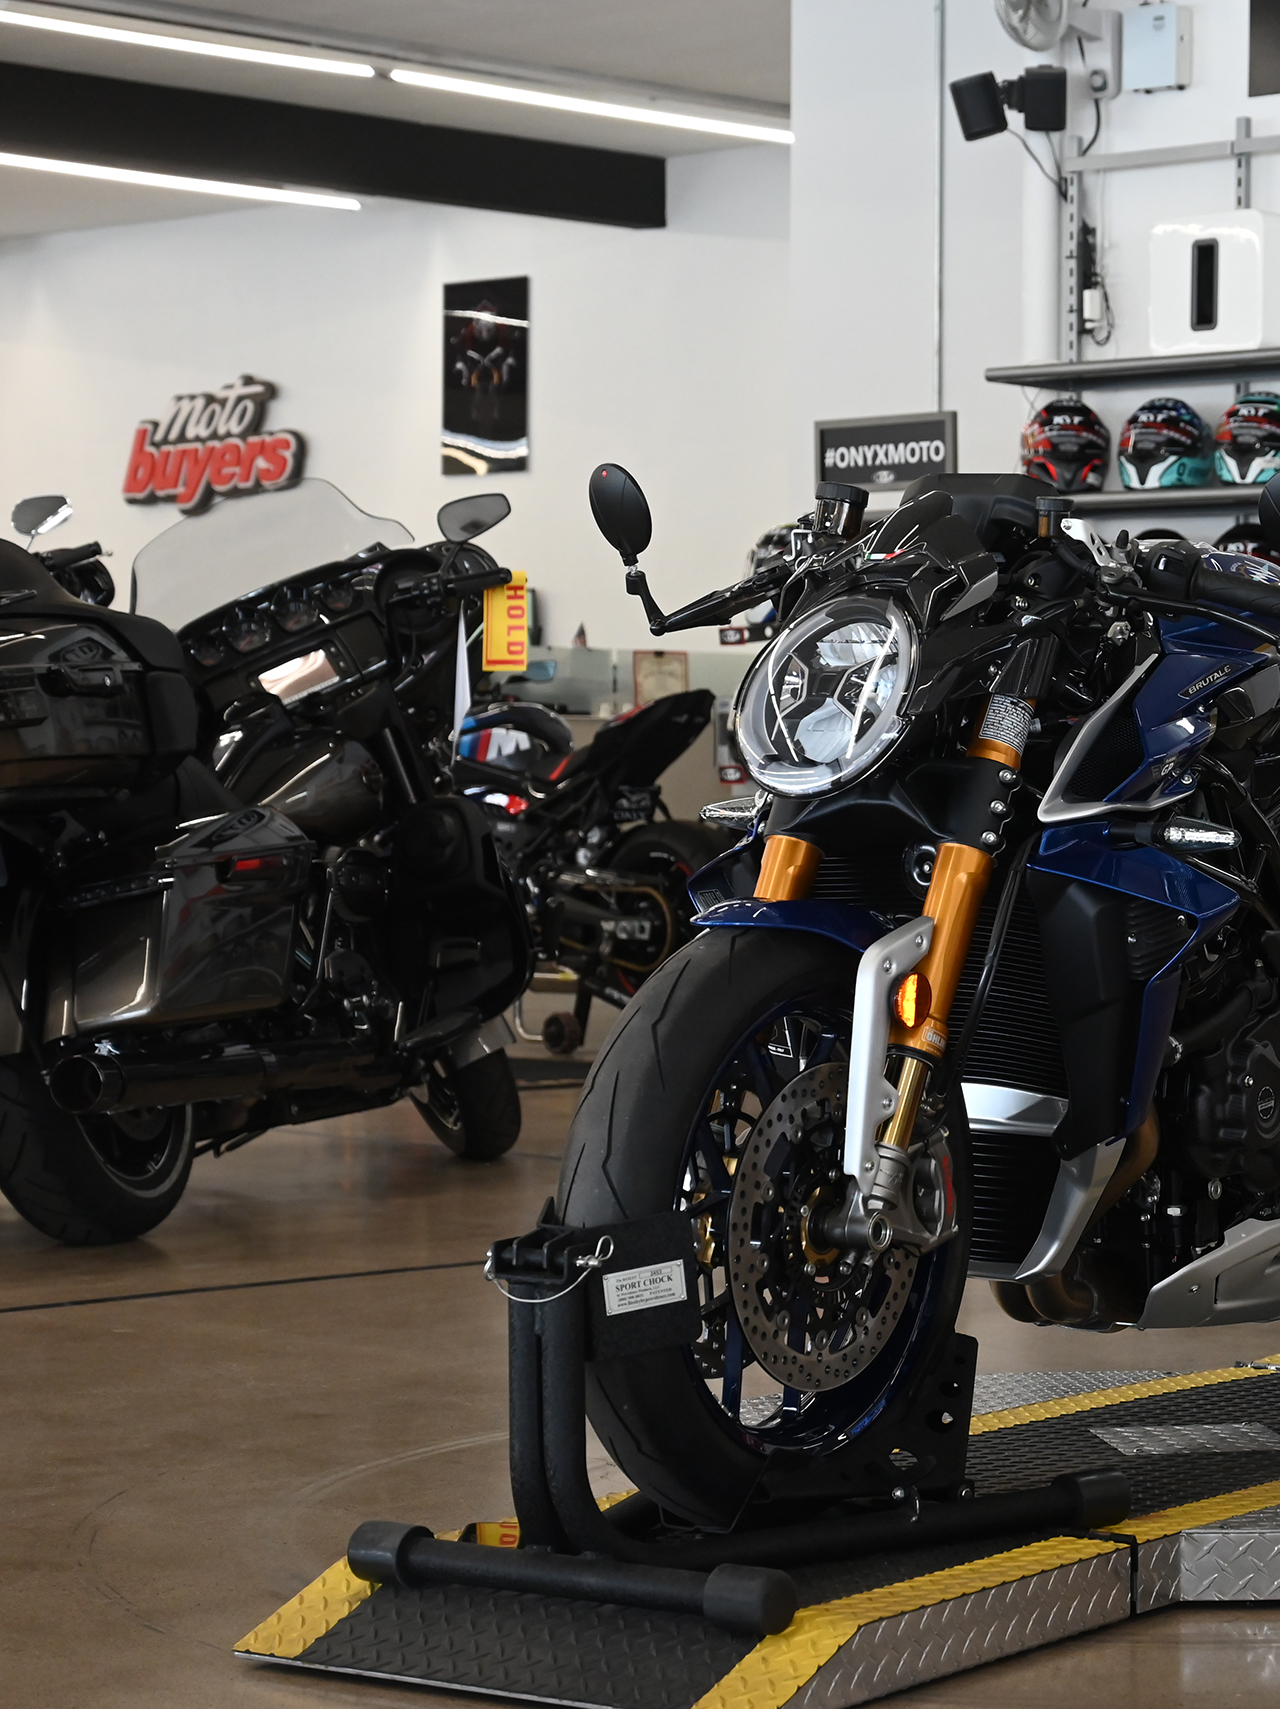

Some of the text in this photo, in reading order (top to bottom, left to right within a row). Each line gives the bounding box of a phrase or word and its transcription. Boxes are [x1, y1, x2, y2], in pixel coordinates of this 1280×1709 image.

[122, 424, 296, 510] buyers
[824, 439, 946, 470] #ONYXMOTO
[505, 585, 526, 656] HOLD
[1187, 664, 1232, 695] BRUTALE
[615, 1274, 673, 1293] SPORT CHOCK
